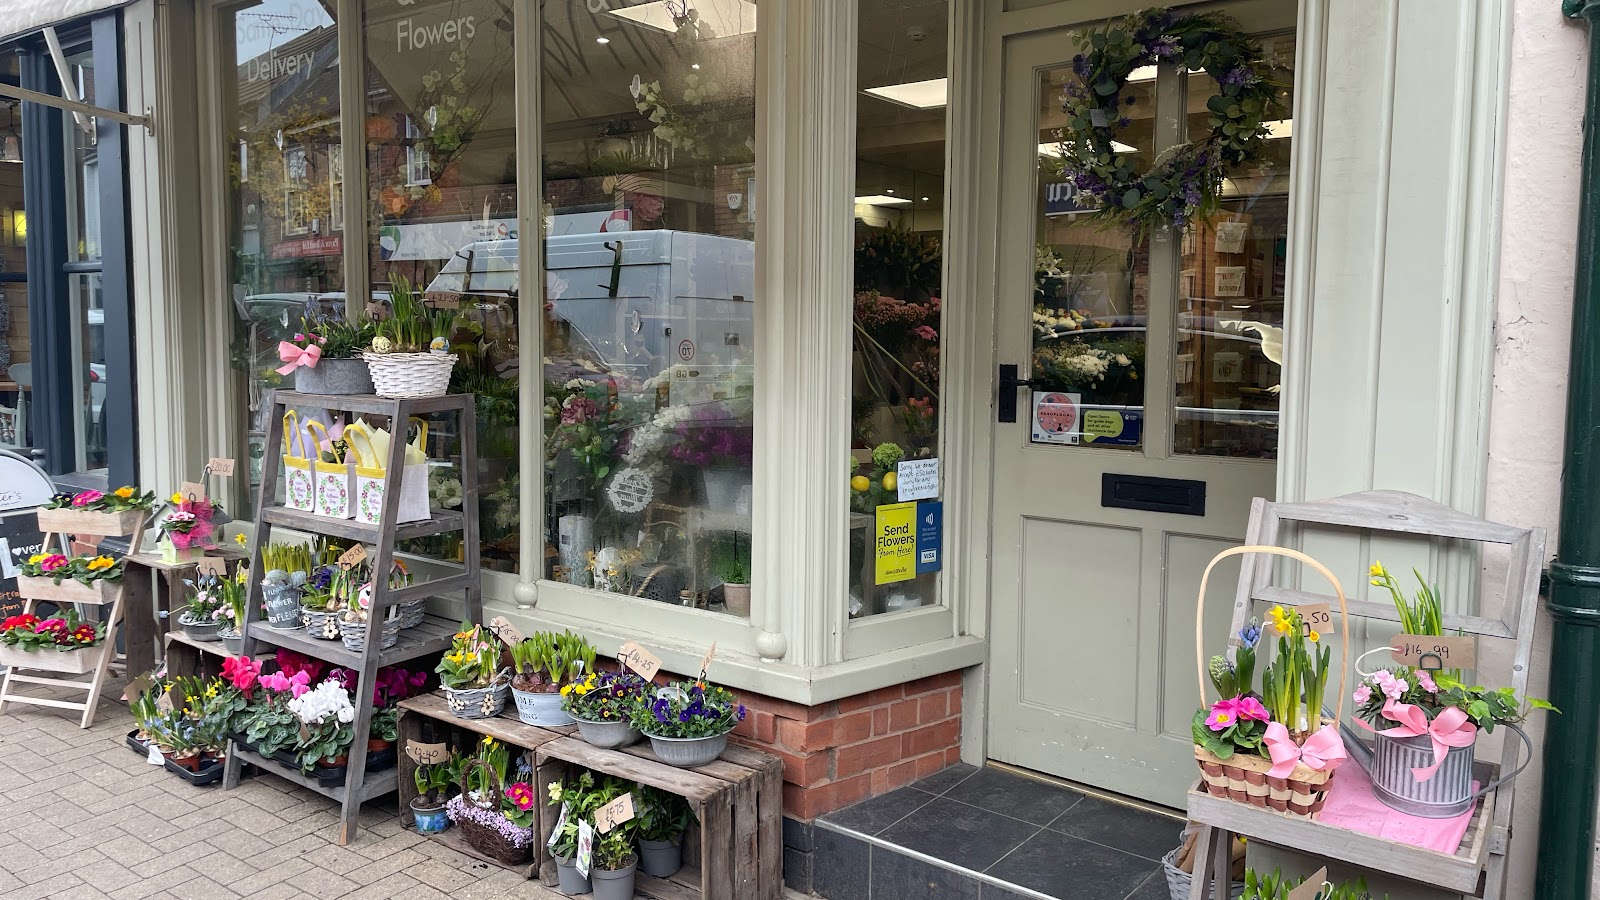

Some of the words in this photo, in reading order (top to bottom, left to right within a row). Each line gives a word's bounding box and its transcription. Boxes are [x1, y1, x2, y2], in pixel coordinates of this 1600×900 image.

[288, 3, 327, 33] Day
[397, 15, 475, 52] Flowers
[247, 51, 315, 82] Delivery
[884, 522, 909, 536] Send
[878, 535, 915, 548] Flowers
[878, 547, 896, 559] From
[897, 544, 914, 556] Here!
[1405, 643, 1449, 658] £16.99
